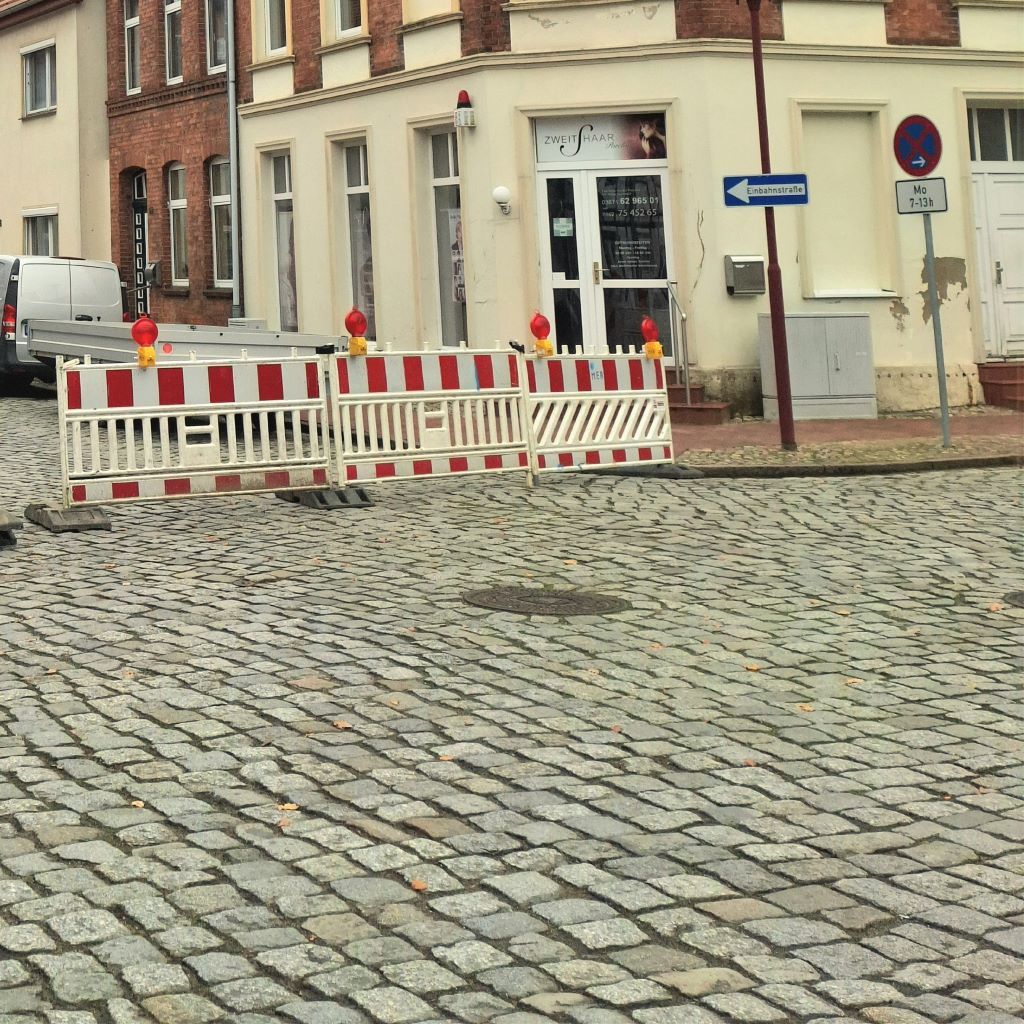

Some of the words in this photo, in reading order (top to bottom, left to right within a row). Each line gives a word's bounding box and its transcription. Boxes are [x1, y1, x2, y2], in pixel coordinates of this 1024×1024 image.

[746, 185, 803, 195] Einbahnstraße
[913, 185, 927, 195] Mo
[620, 197, 630, 205] 62
[632, 197, 647, 205] 965
[649, 196, 659, 204] 01
[618, 209, 628, 217] 75
[629, 208, 645, 217] 452
[646, 208, 657, 216] 65
